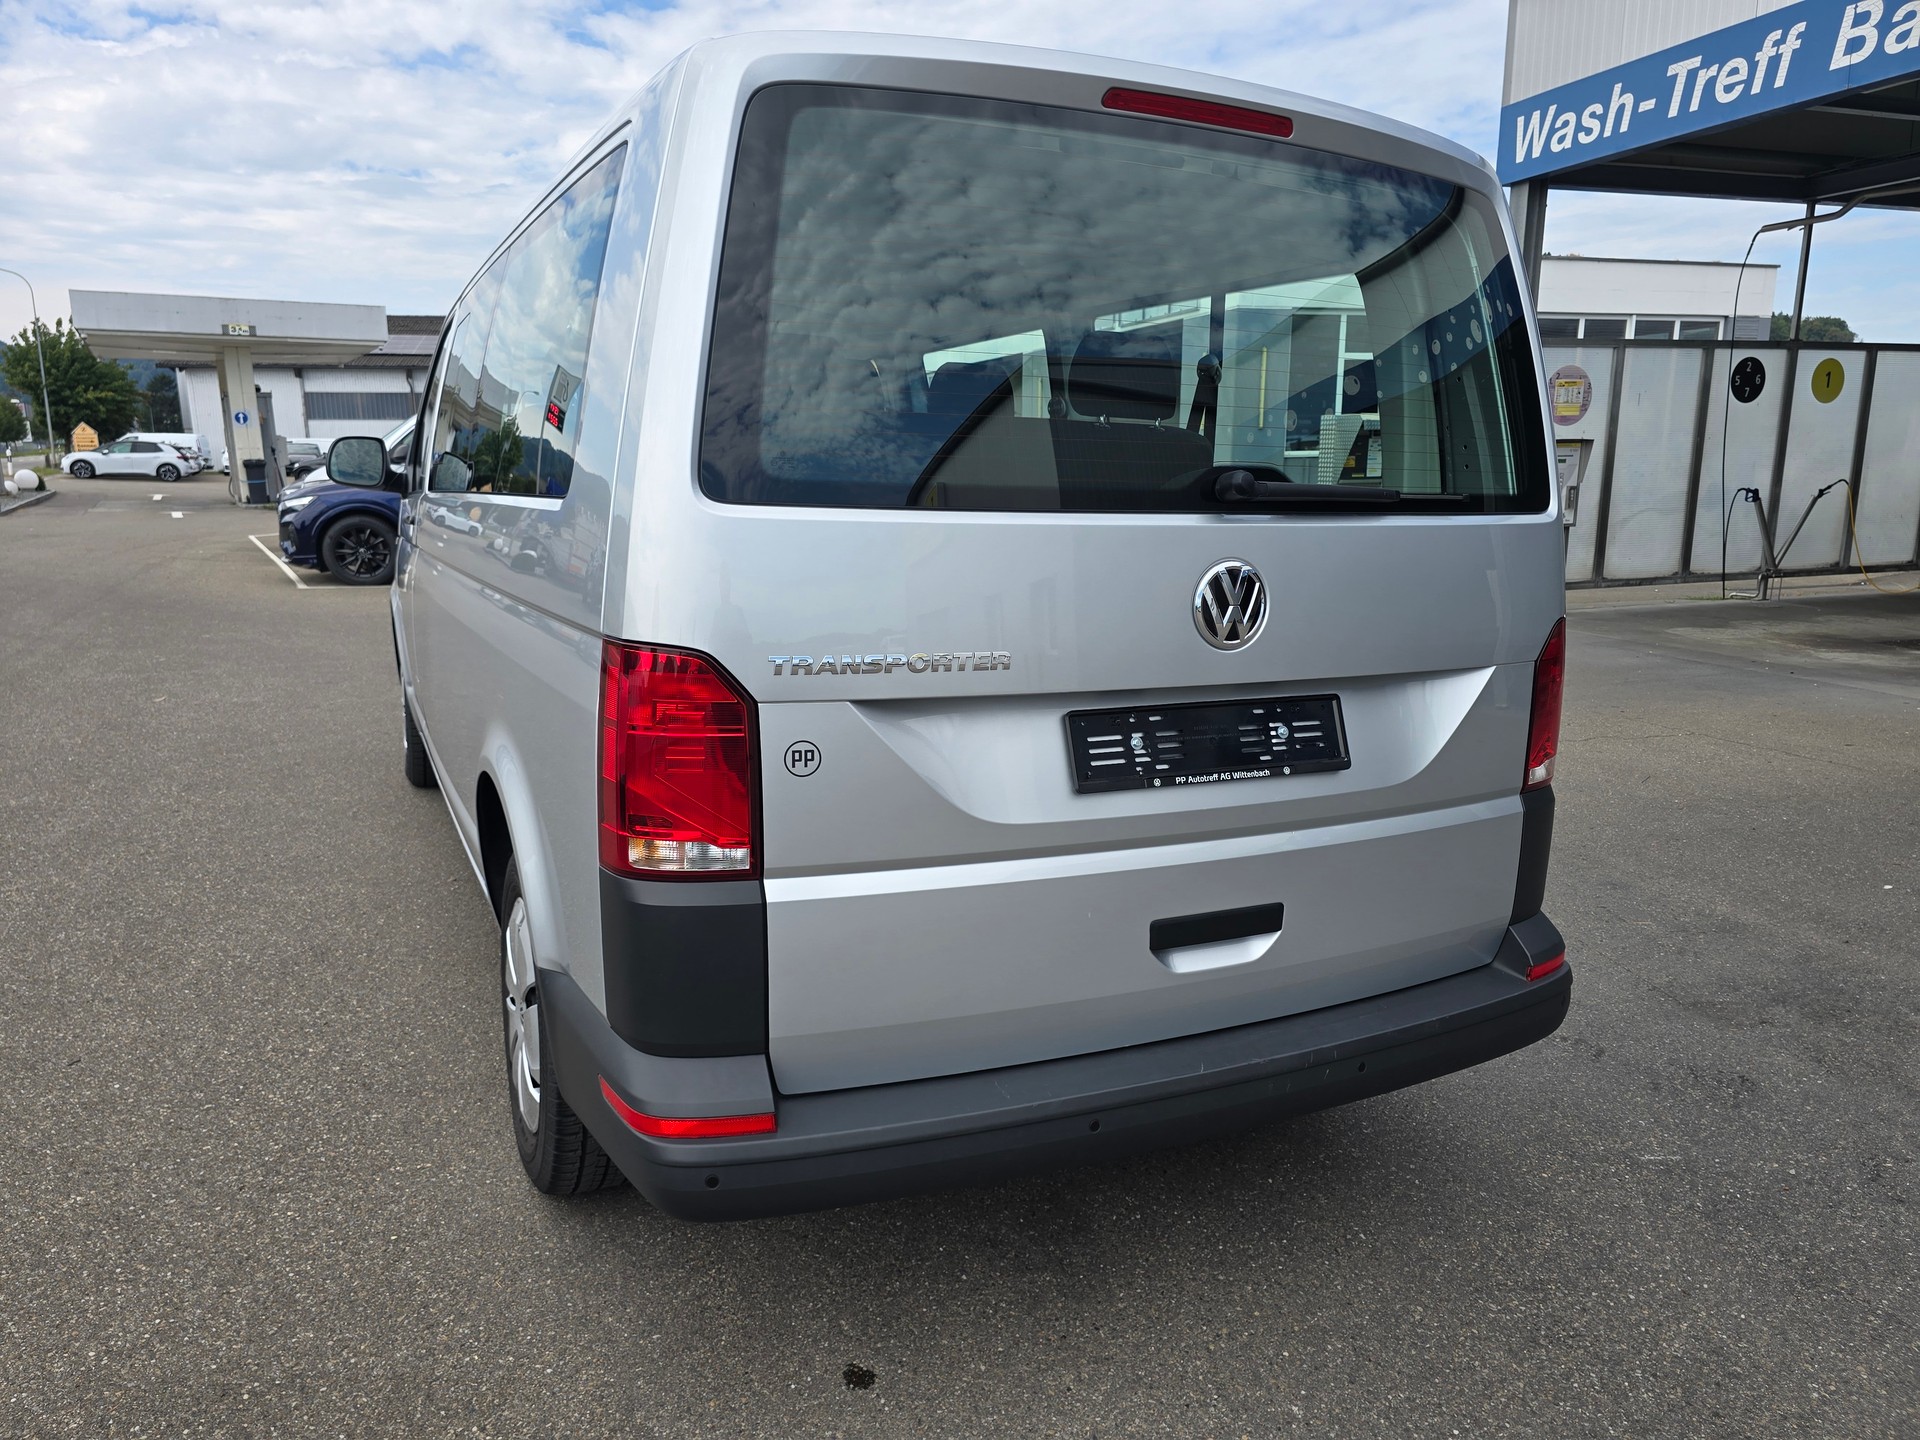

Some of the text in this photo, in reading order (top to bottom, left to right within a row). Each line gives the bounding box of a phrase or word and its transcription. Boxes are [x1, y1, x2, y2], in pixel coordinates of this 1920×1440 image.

[1515, 0, 1920, 164] Wash-Treff Ba
[1746, 361, 1752, 372] 2
[1734, 375, 1741, 386] 5
[1755, 374, 1761, 385] 6
[1825, 370, 1832, 389] 1
[1744, 387, 1750, 398] 7
[767, 651, 1012, 676] TRANSPORTER
[791, 749, 815, 768] PP
[1175, 769, 1271, 785] PP Autotreff AG Wittenbach
